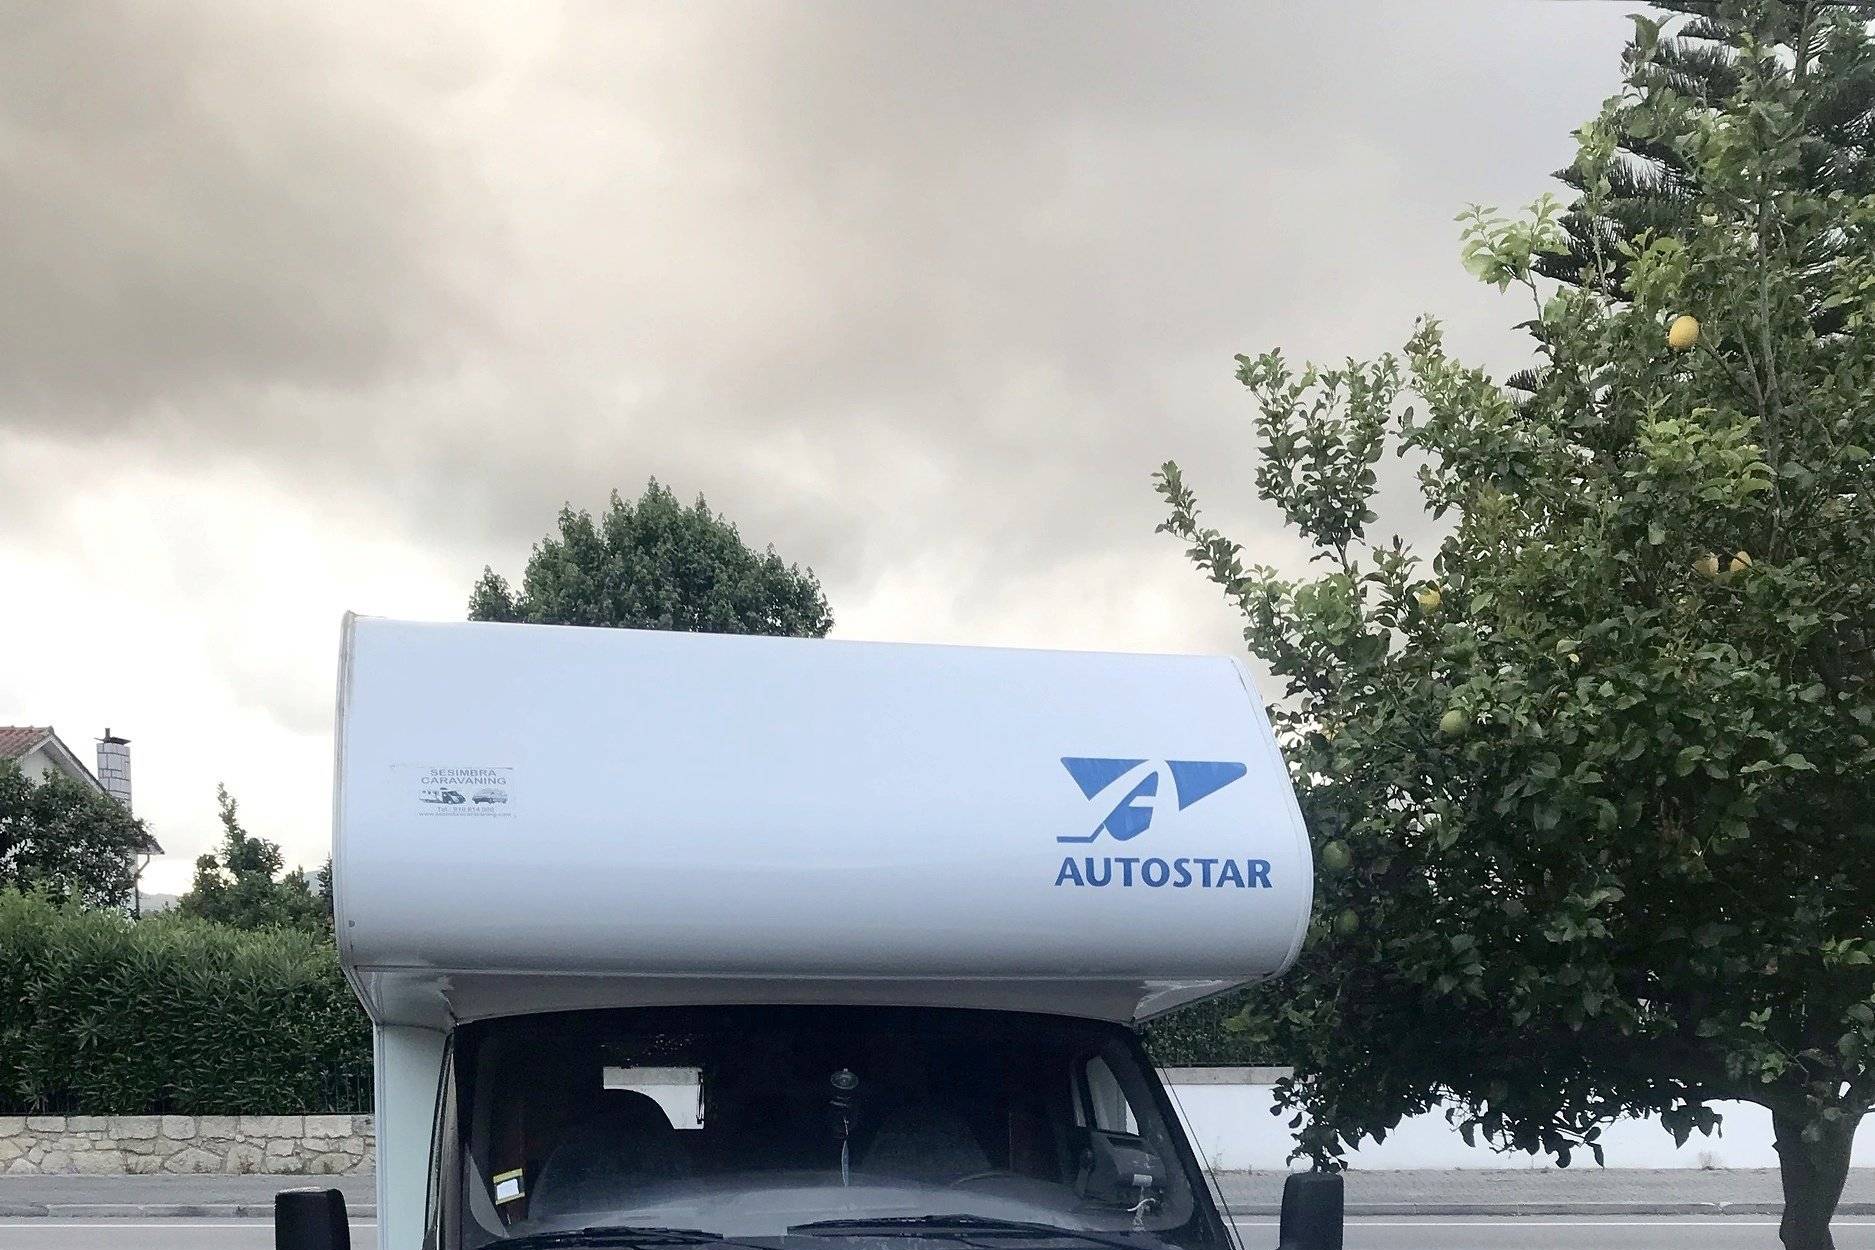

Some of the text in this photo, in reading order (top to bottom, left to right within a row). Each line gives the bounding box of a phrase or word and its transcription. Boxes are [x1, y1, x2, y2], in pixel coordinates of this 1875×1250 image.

[430, 768, 497, 777] SESIMBRA
[421, 776, 507, 785] CARAVANING
[1054, 856, 1273, 889] AUTOSTAR
